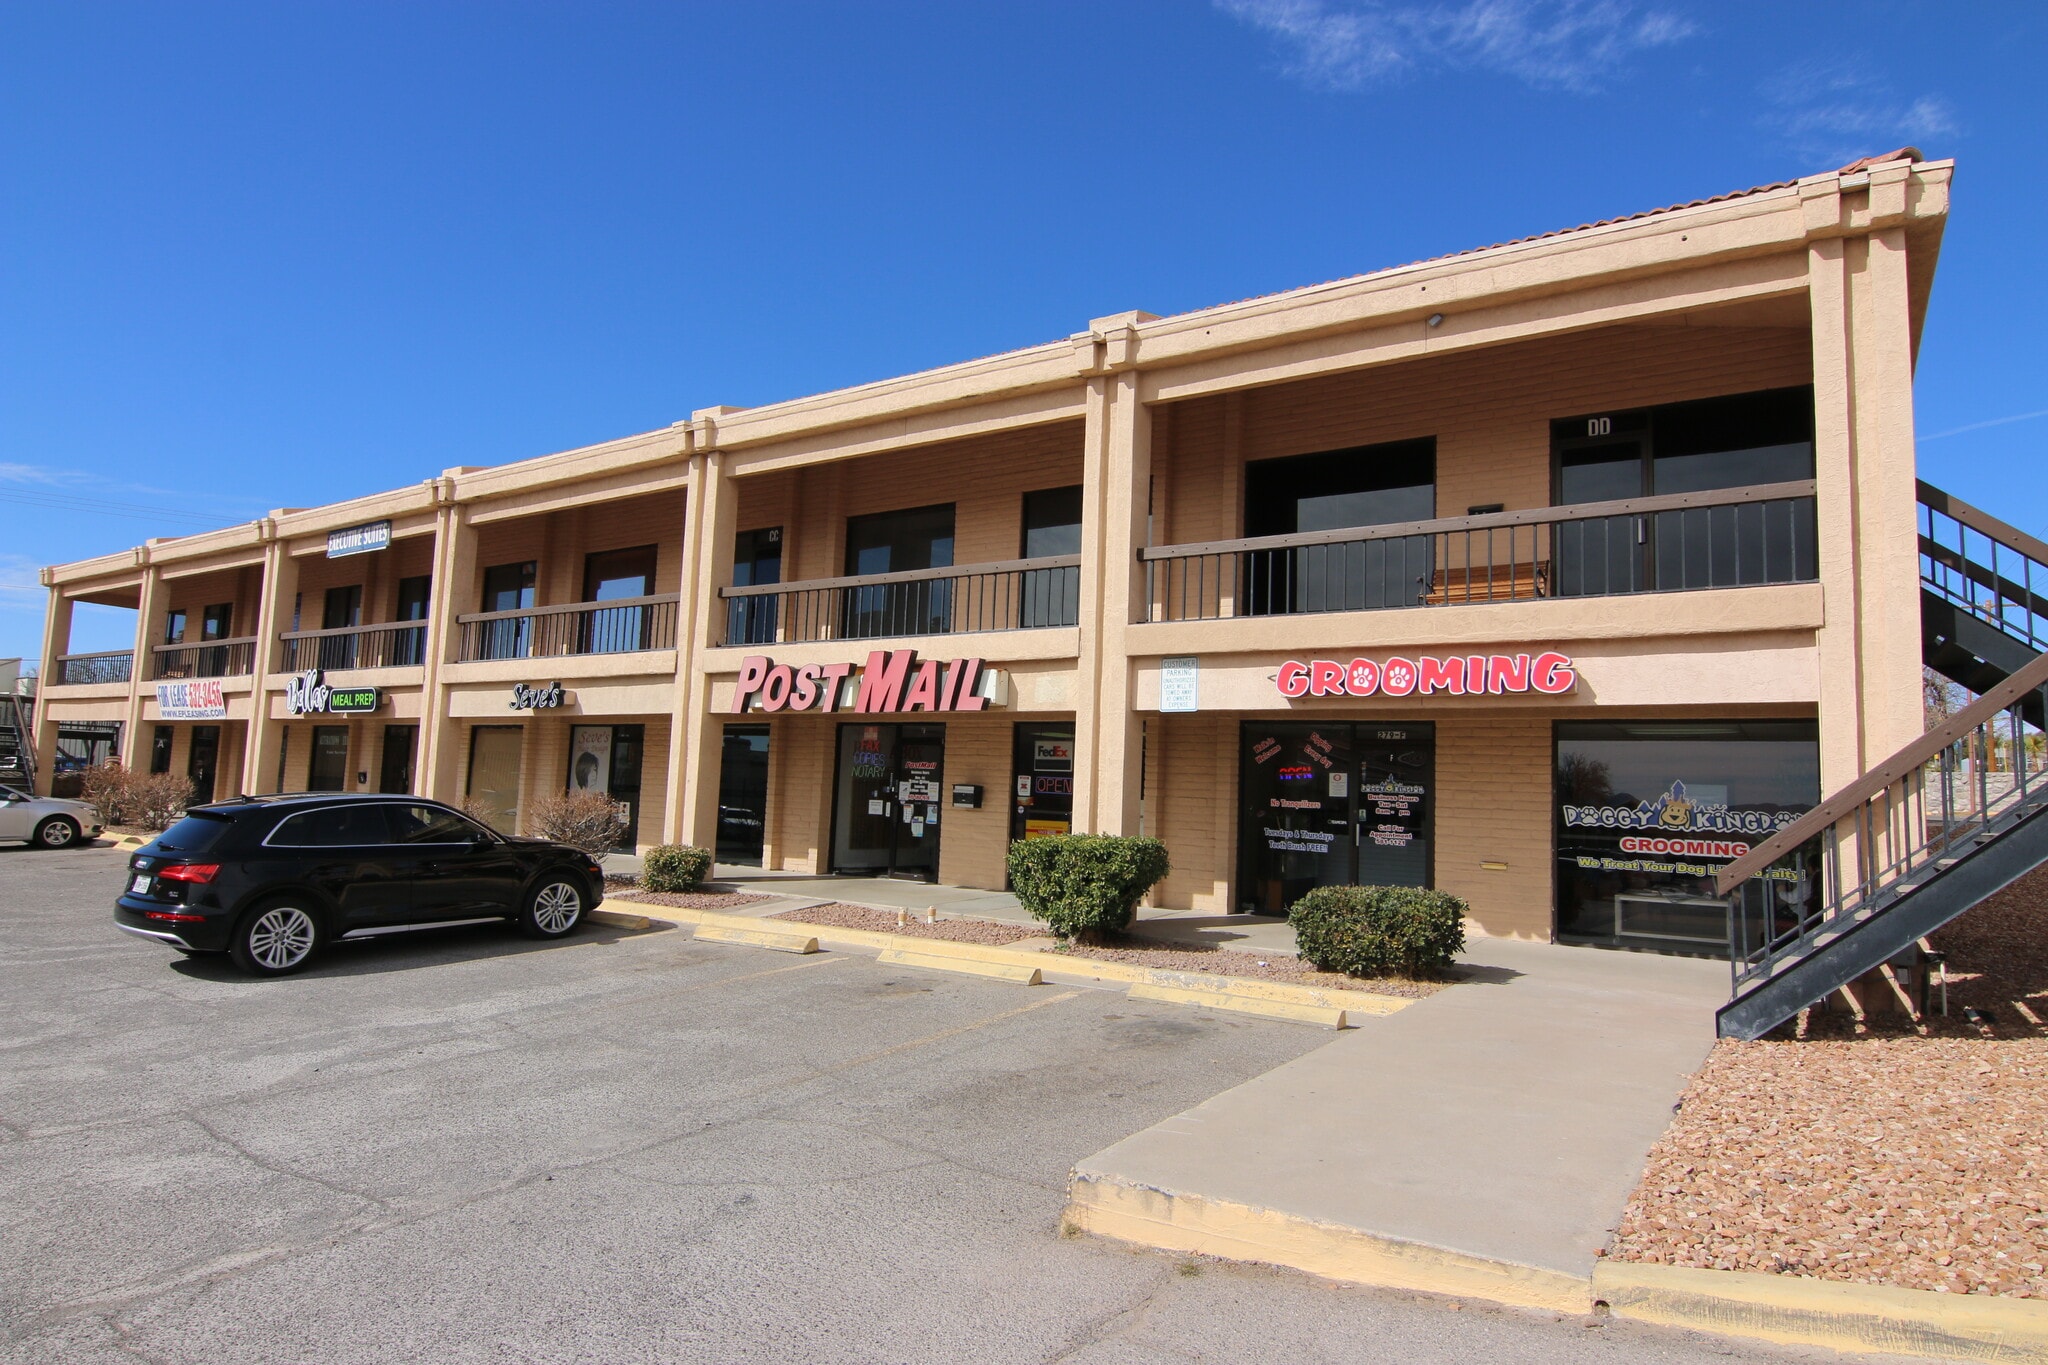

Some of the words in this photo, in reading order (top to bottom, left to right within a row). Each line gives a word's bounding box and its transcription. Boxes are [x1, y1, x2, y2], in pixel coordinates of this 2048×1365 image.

[1588, 417, 1610, 437] DD
[328, 528, 363, 551] EXECUTIVE
[363, 522, 388, 545] SUITES
[1163, 659, 1196, 668] CUSTOMER
[1167, 669, 1193, 677] PARKING
[1275, 651, 1576, 698] GROOMING
[158, 685, 170, 708] FOR
[170, 684, 188, 708] LEASE
[189, 680, 223, 709] 532-3456
[332, 694, 353, 706] MEAL
[354, 693, 374, 706] PREP
[509, 681, 560, 710] Seve's
[161, 709, 225, 718] WWW.EPLEASING.COM
[862, 740, 880, 751] FAX
[1310, 731, 1333, 753] Dipping
[1037, 746, 1068, 757] FedEx
[1304, 744, 1322, 761] Every
[853, 752, 886, 767] COPIES
[851, 765, 886, 778] NOTARY
[1037, 779, 1072, 793] OPEN
[1270, 798, 1280, 807] No
[1264, 827, 1293, 839] Tuesdays
[1300, 830, 1334, 842] Thursdays
[1369, 830, 1412, 840] Appointment
[1268, 840, 1286, 850] Teeth
[1287, 841, 1306, 851] Brush
[1620, 837, 1751, 858] GROOMING
[1577, 856, 1600, 868] We
[1601, 858, 1639, 871] Treat
[1639, 860, 1675, 873] Your
[1676, 862, 1707, 877] Dog
